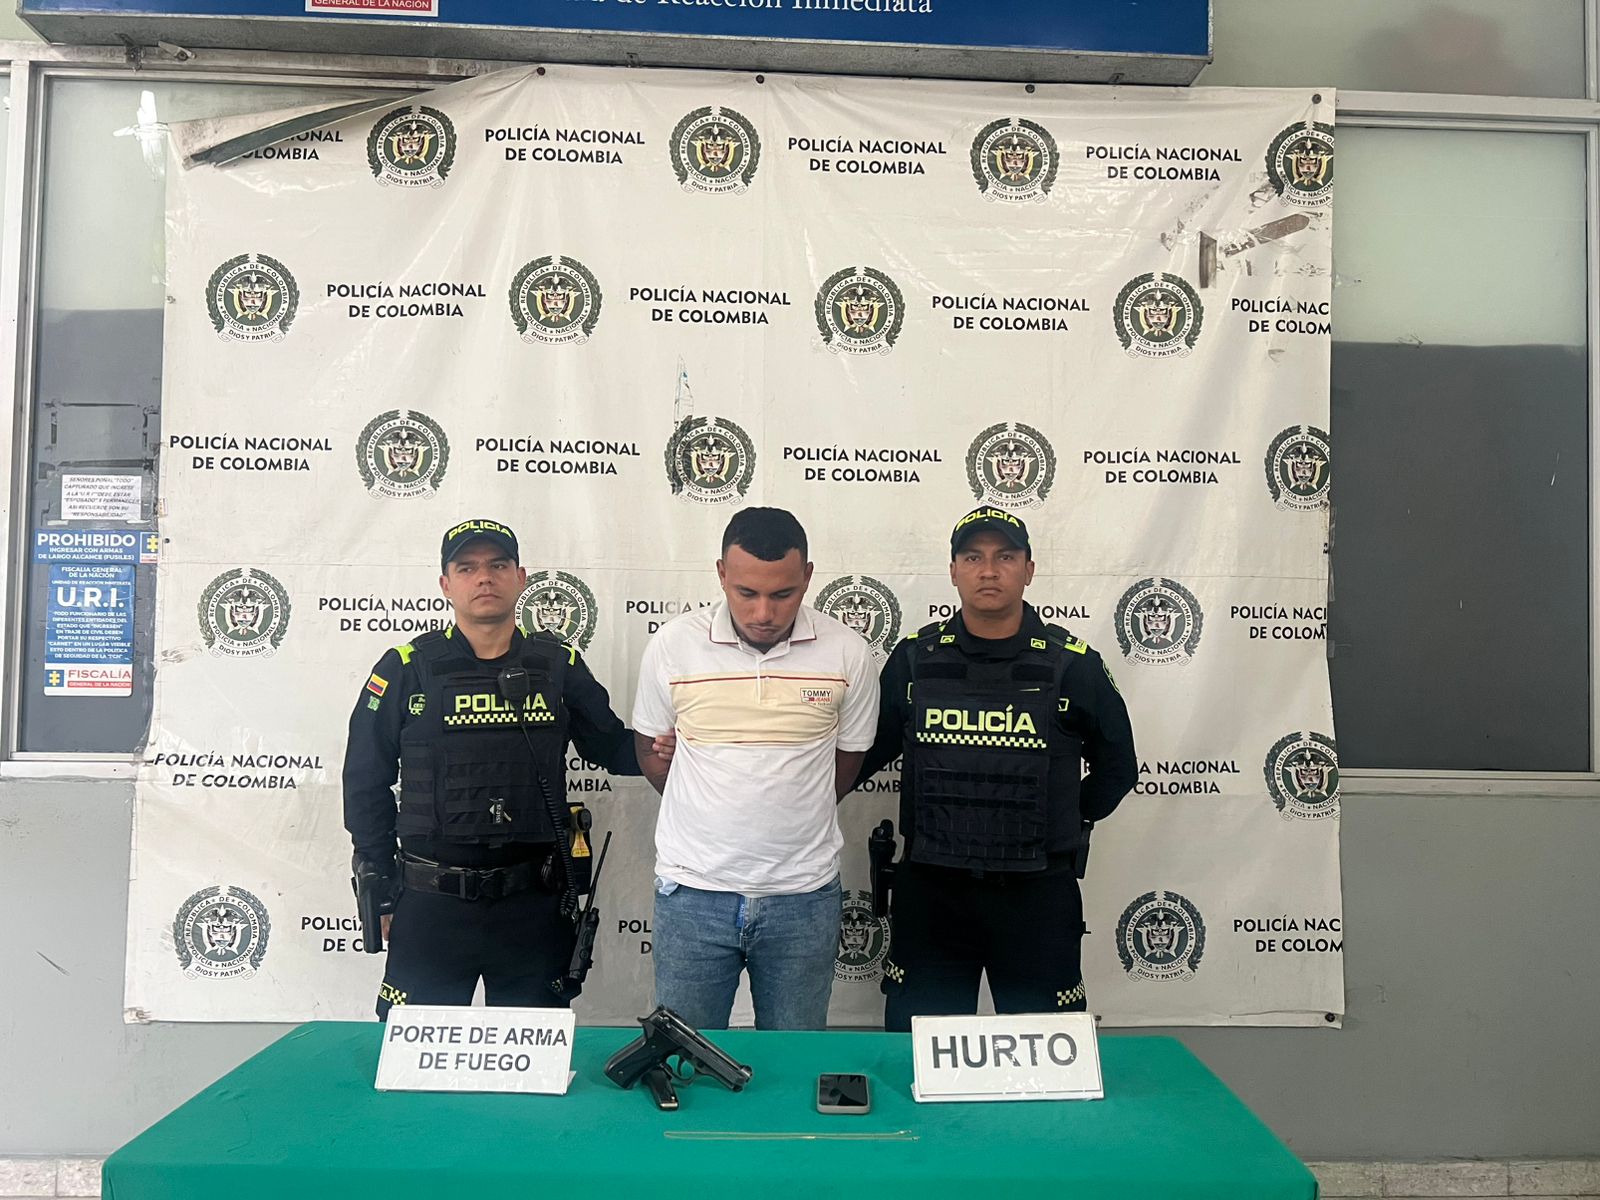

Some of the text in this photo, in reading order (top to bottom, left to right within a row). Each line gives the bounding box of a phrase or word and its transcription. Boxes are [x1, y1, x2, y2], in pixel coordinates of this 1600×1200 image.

[290, 127, 343, 142] ONAL
[486, 124, 645, 144] POLICÍA NACIONAL
[789, 136, 946, 153] POLICÍA NACIONAL
[506, 148, 622, 163] DE COLOMBIA
[1087, 144, 1242, 161] POLICÍA NACIONAL
[810, 159, 924, 174] DE COLOMBIA
[1108, 167, 1220, 181] DE COLOMBIA
[266, 268, 288, 304] COLOMBIA
[328, 282, 486, 298] POLICÍA NACIONAL
[631, 286, 790, 305] POLICÍA NACIONAL
[933, 294, 1089, 311] POLICÍA NACIONAL
[349, 303, 463, 318] DE COLOMBIA
[1232, 297, 1292, 312] POLICÍA
[252, 312, 284, 332] NACIONAL
[652, 309, 768, 324] DE COLOMBIA
[954, 317, 1068, 330] DE COLOMBIA
[1249, 320, 1269, 332] DE
[252, 330, 276, 340] PATRIA
[170, 433, 332, 450] POLICÍA NACIONAL
[477, 436, 640, 455] POLICÍA NACIONAL
[784, 445, 941, 462] POLICÍA NACIONAL
[1084, 447, 1240, 464] POLICÍA NACIONAL
[193, 457, 309, 470] DE COLOMBIA
[498, 459, 617, 474] DE COLOMBIA
[805, 468, 920, 482] DE COLOMBIA
[1106, 470, 1218, 483] DE COLOMBIA
[38, 533, 136, 546] PROHIBIDO
[57, 587, 124, 608] U.R.I.
[319, 594, 386, 611] POLICÍA
[1231, 603, 1288, 619] POLICÍA
[341, 619, 361, 631] DE
[1250, 627, 1267, 638] DE
[68, 668, 131, 679] FISCALÍA
[925, 704, 1036, 734] POLICÍA
[155, 751, 322, 768] POLICÍA NACIONAL
[1157, 760, 1240, 774] NACIONAL
[173, 774, 296, 788] DE COLOMBIA
[1133, 780, 1220, 794] COLOMBIA
[301, 916, 362, 931] POLICÍ
[1173, 905, 1194, 940] COLOMBIA
[1234, 915, 1298, 932] POLICÍA
[323, 938, 346, 952] DE
[1256, 940, 1275, 952] DE
[1161, 950, 1192, 970] NACIONAL
[1161, 969, 1185, 980] PATRIA
[389, 1025, 567, 1046] PORTE DE ARMA
[932, 1033, 1077, 1068] HURTO
[419, 1053, 530, 1071] DE FUEGO
